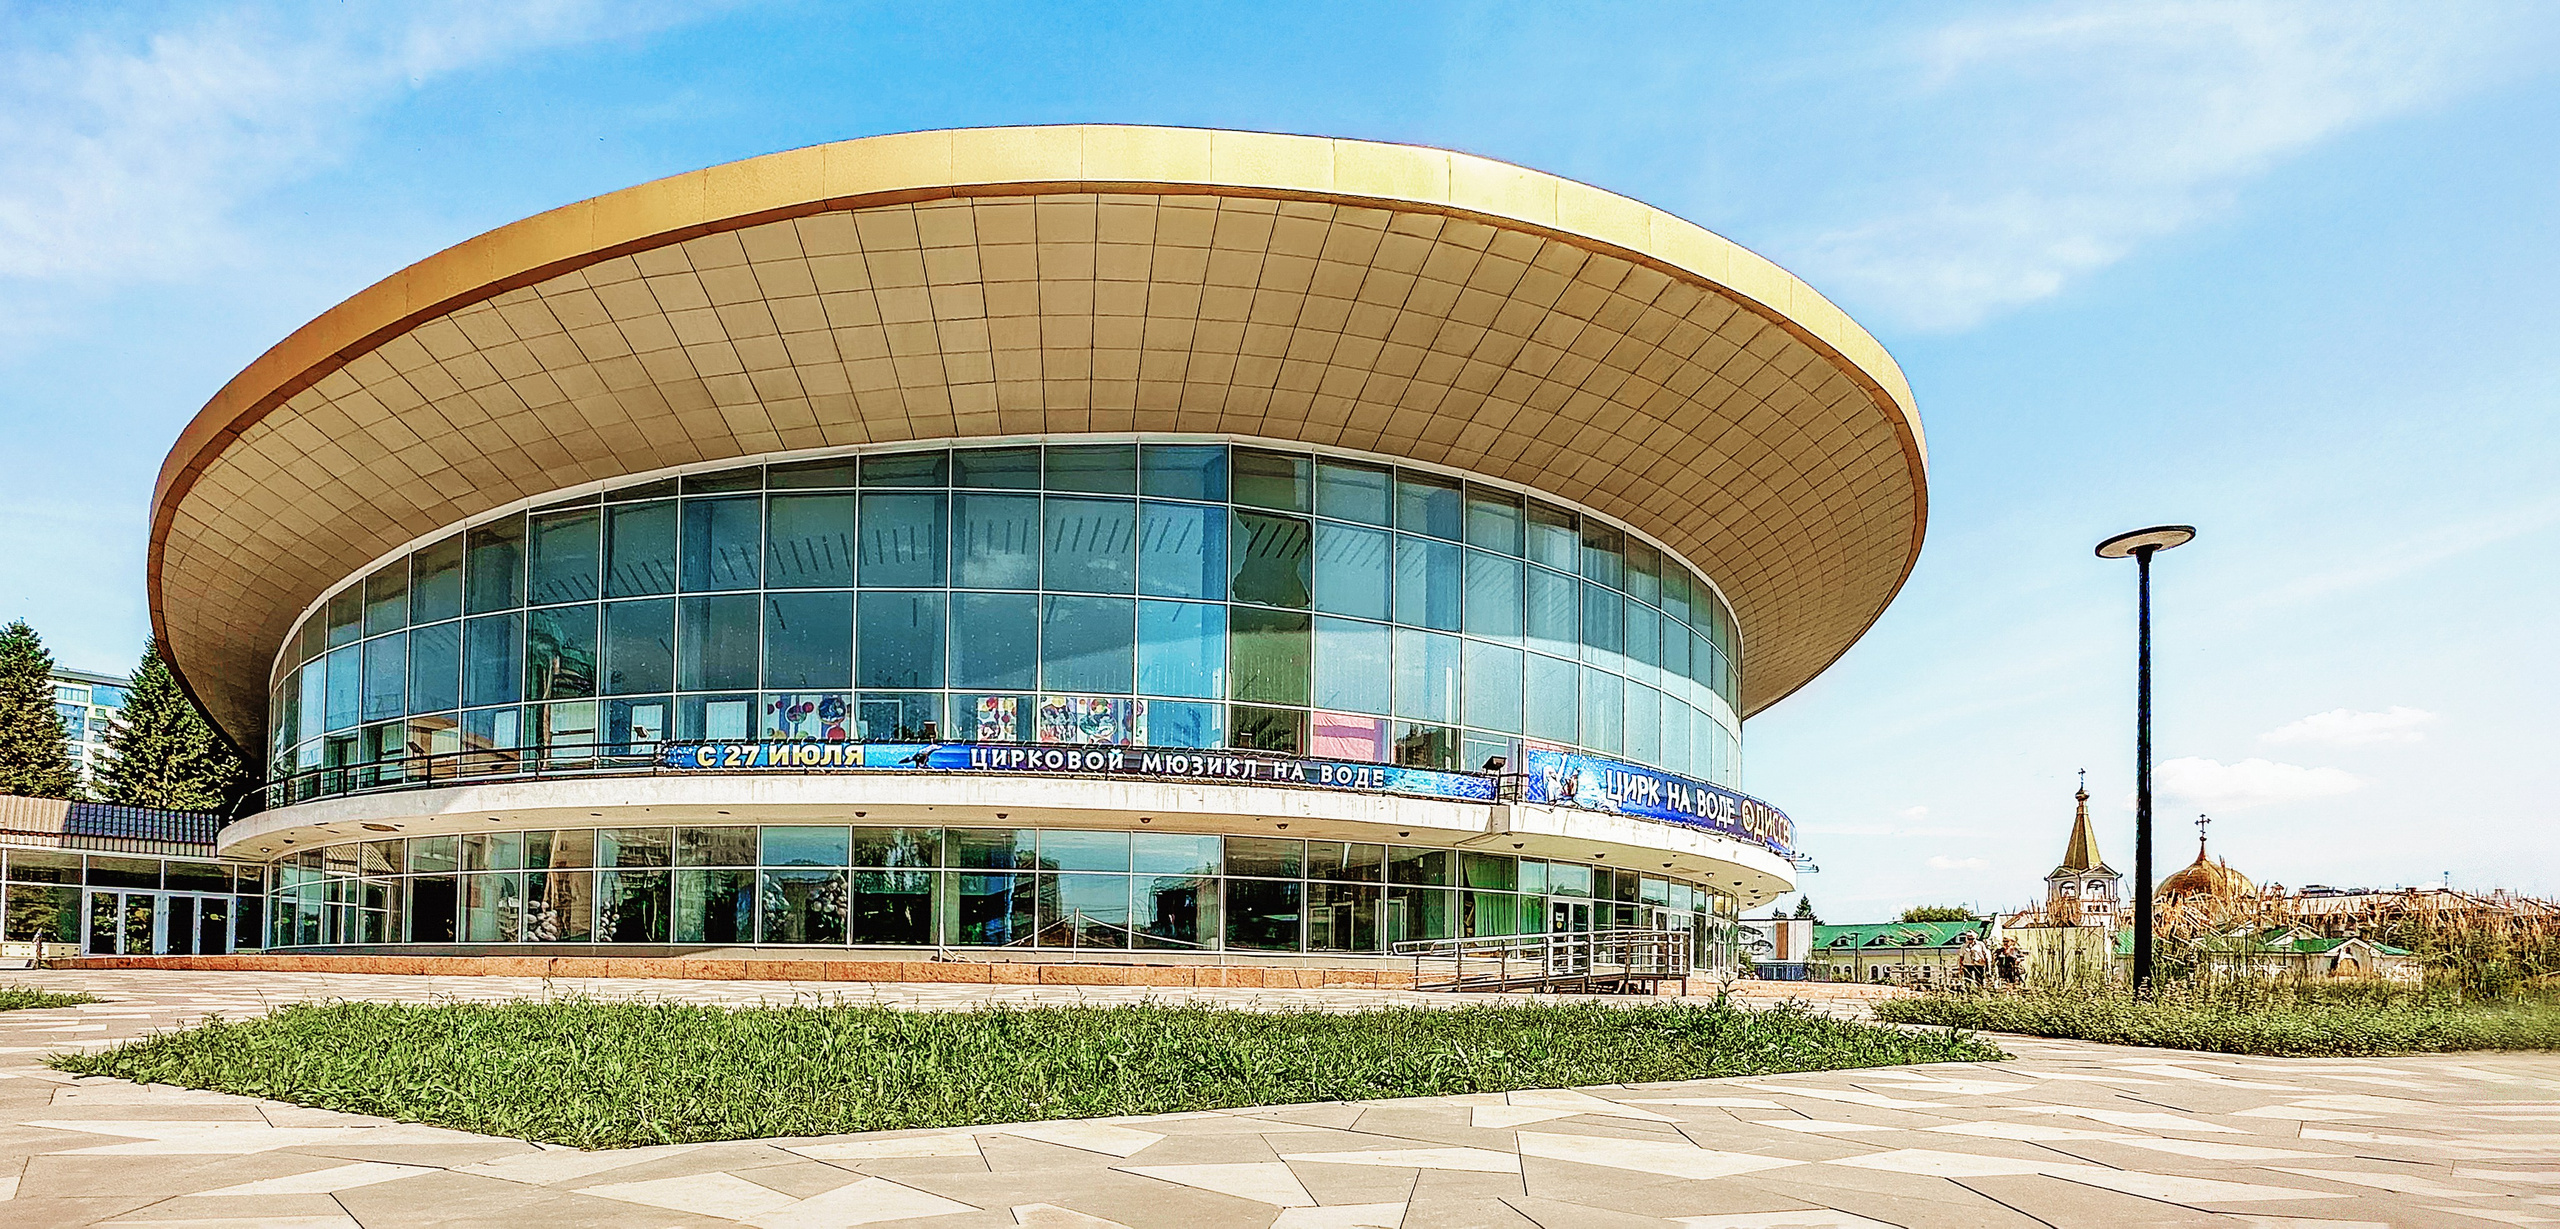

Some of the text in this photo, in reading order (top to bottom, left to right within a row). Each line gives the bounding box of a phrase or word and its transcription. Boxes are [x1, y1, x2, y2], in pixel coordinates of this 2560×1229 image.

[697, 744, 865, 767] С 27 ИЮЛЯ
[970, 748, 1385, 789] ЦИРКОВОЙ МЮЗИКЛ НА ВОДЕ
[1606, 769, 1660, 807] ЦИРК
[1667, 782, 1692, 814] НА
[1697, 789, 1735, 829] ВОДЕ
